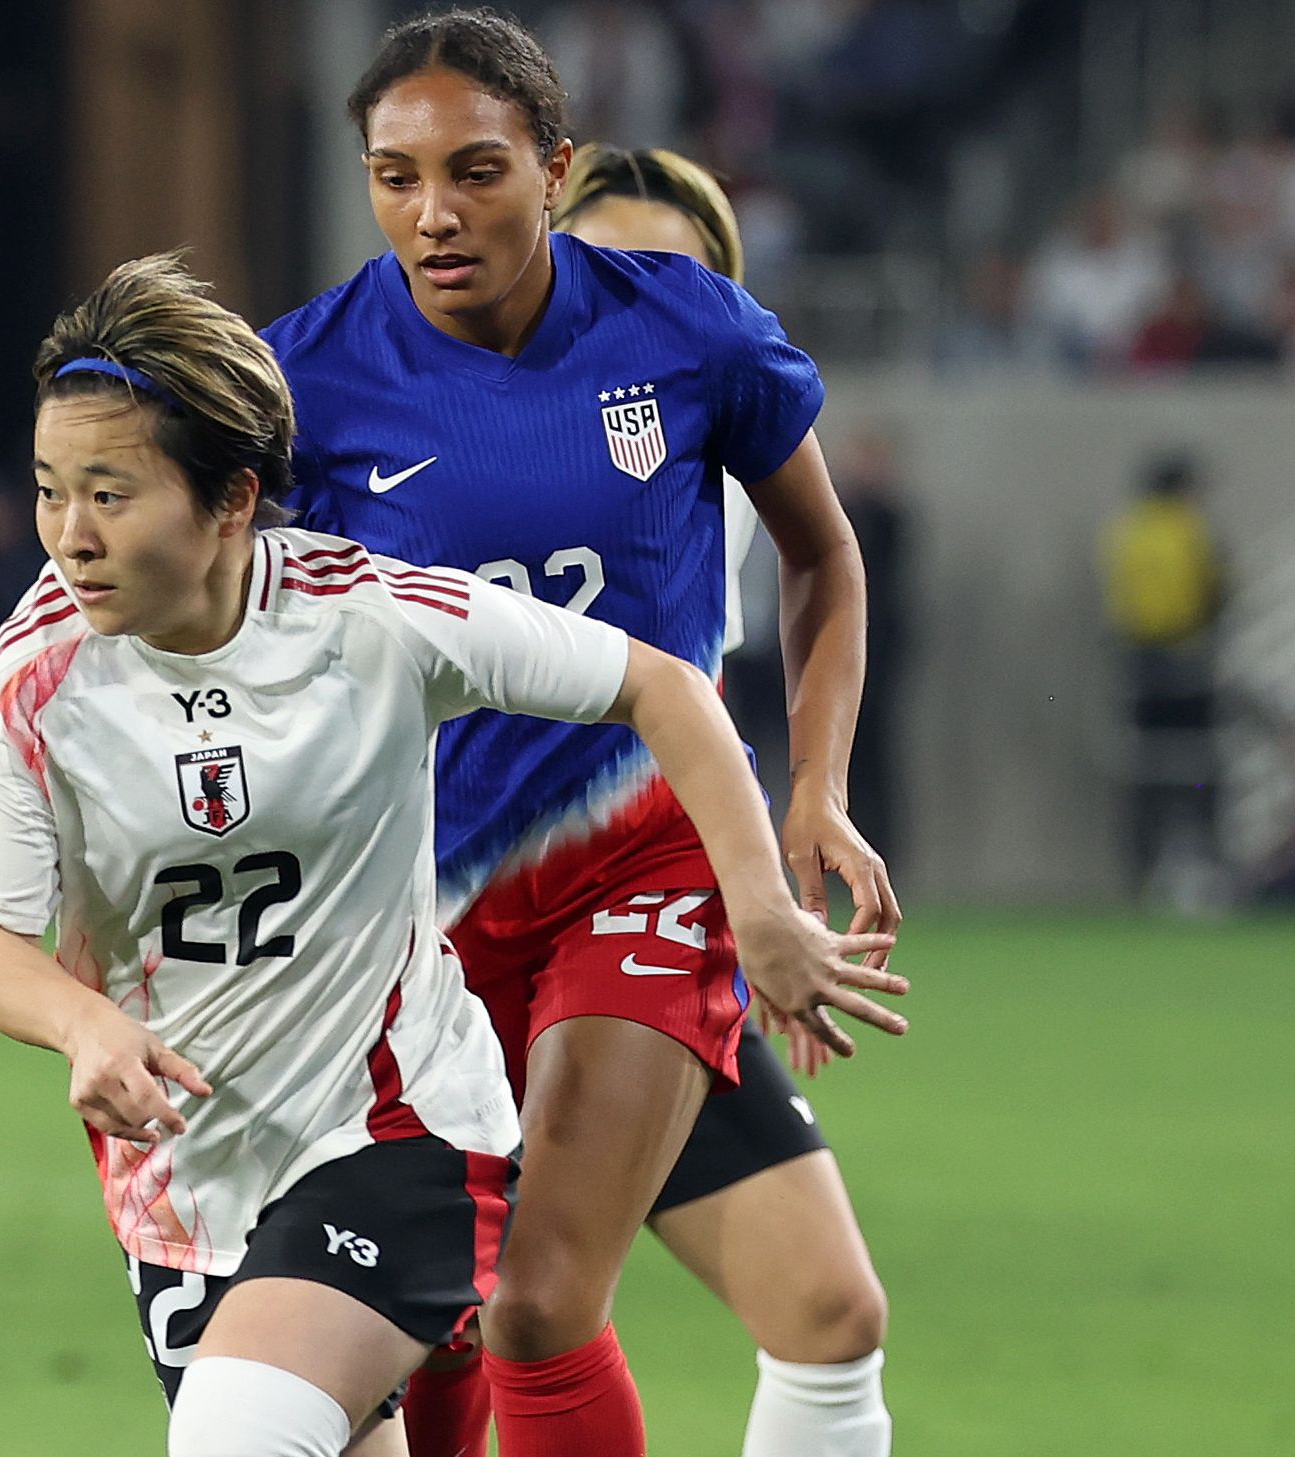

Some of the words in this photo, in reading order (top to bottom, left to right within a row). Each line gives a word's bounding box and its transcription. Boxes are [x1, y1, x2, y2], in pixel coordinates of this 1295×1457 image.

[606, 404, 656, 436] USA
[172, 688, 232, 723] Y-3
[190, 748, 228, 762] JAPAN
[203, 808, 234, 825] JFA
[155, 850, 302, 966] 22
[322, 1223, 381, 1268] Y-3
